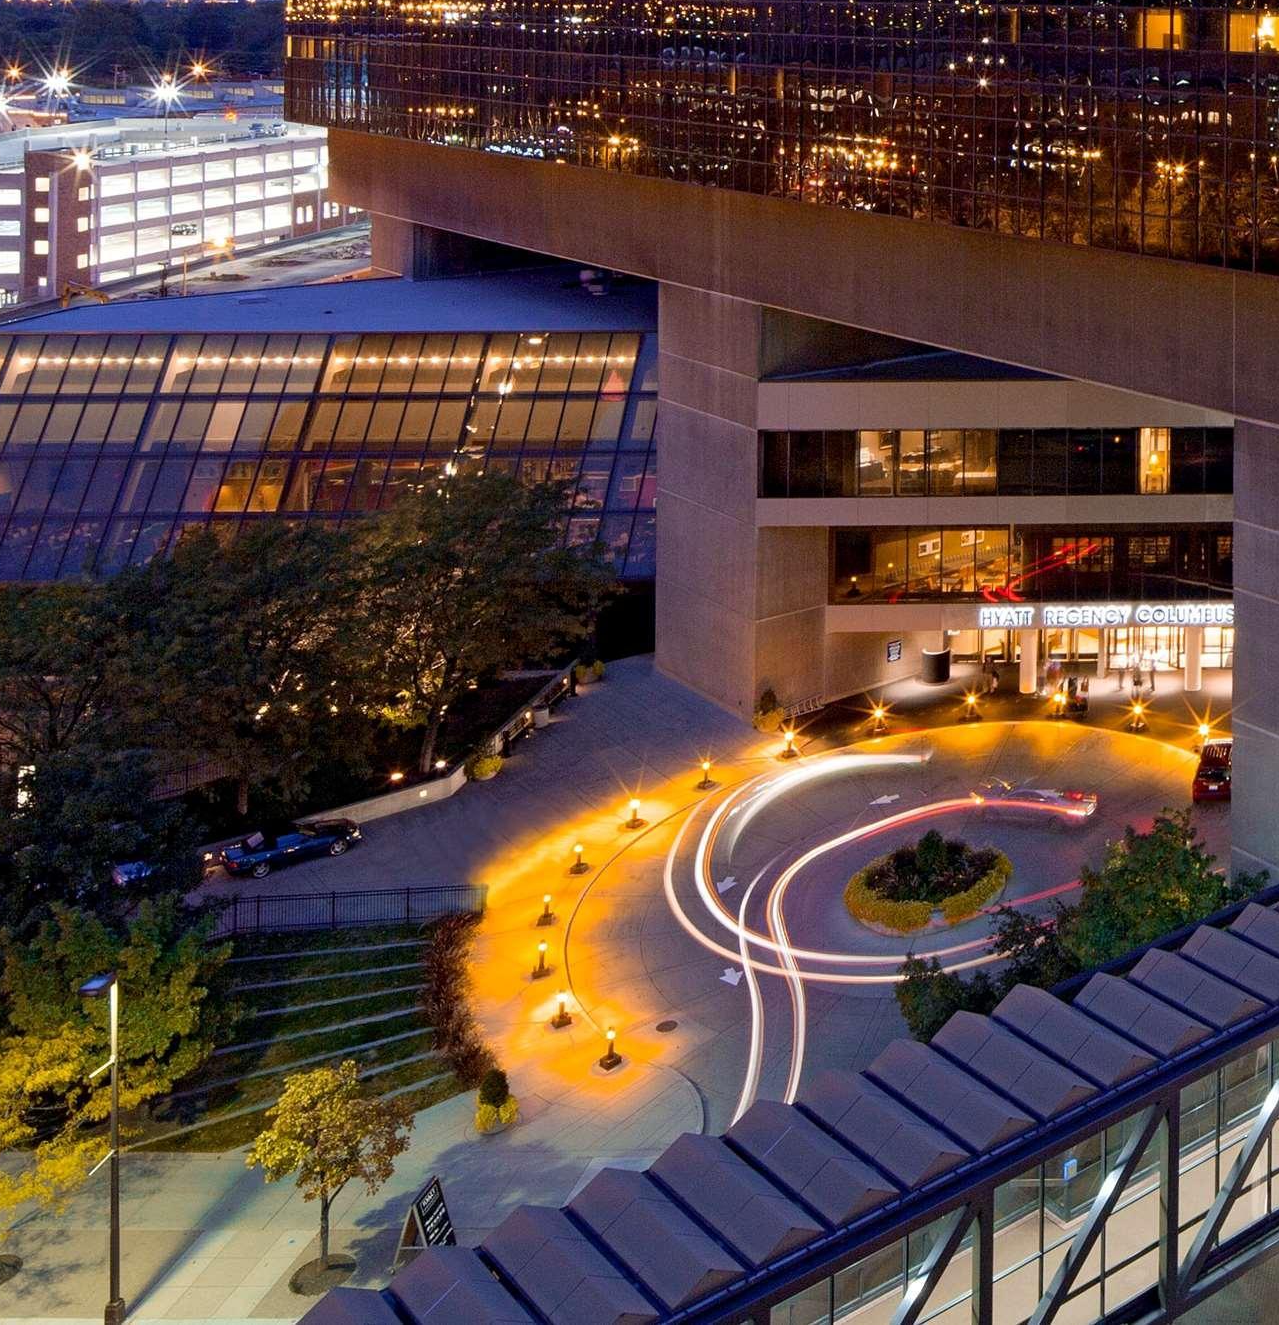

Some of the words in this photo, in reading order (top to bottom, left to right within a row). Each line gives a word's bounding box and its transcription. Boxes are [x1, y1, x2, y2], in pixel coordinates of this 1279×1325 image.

[980, 607, 1033, 626] HYATT
[1044, 605, 1131, 625] REGENCY
[1136, 603, 1234, 624] COLUMBUS
